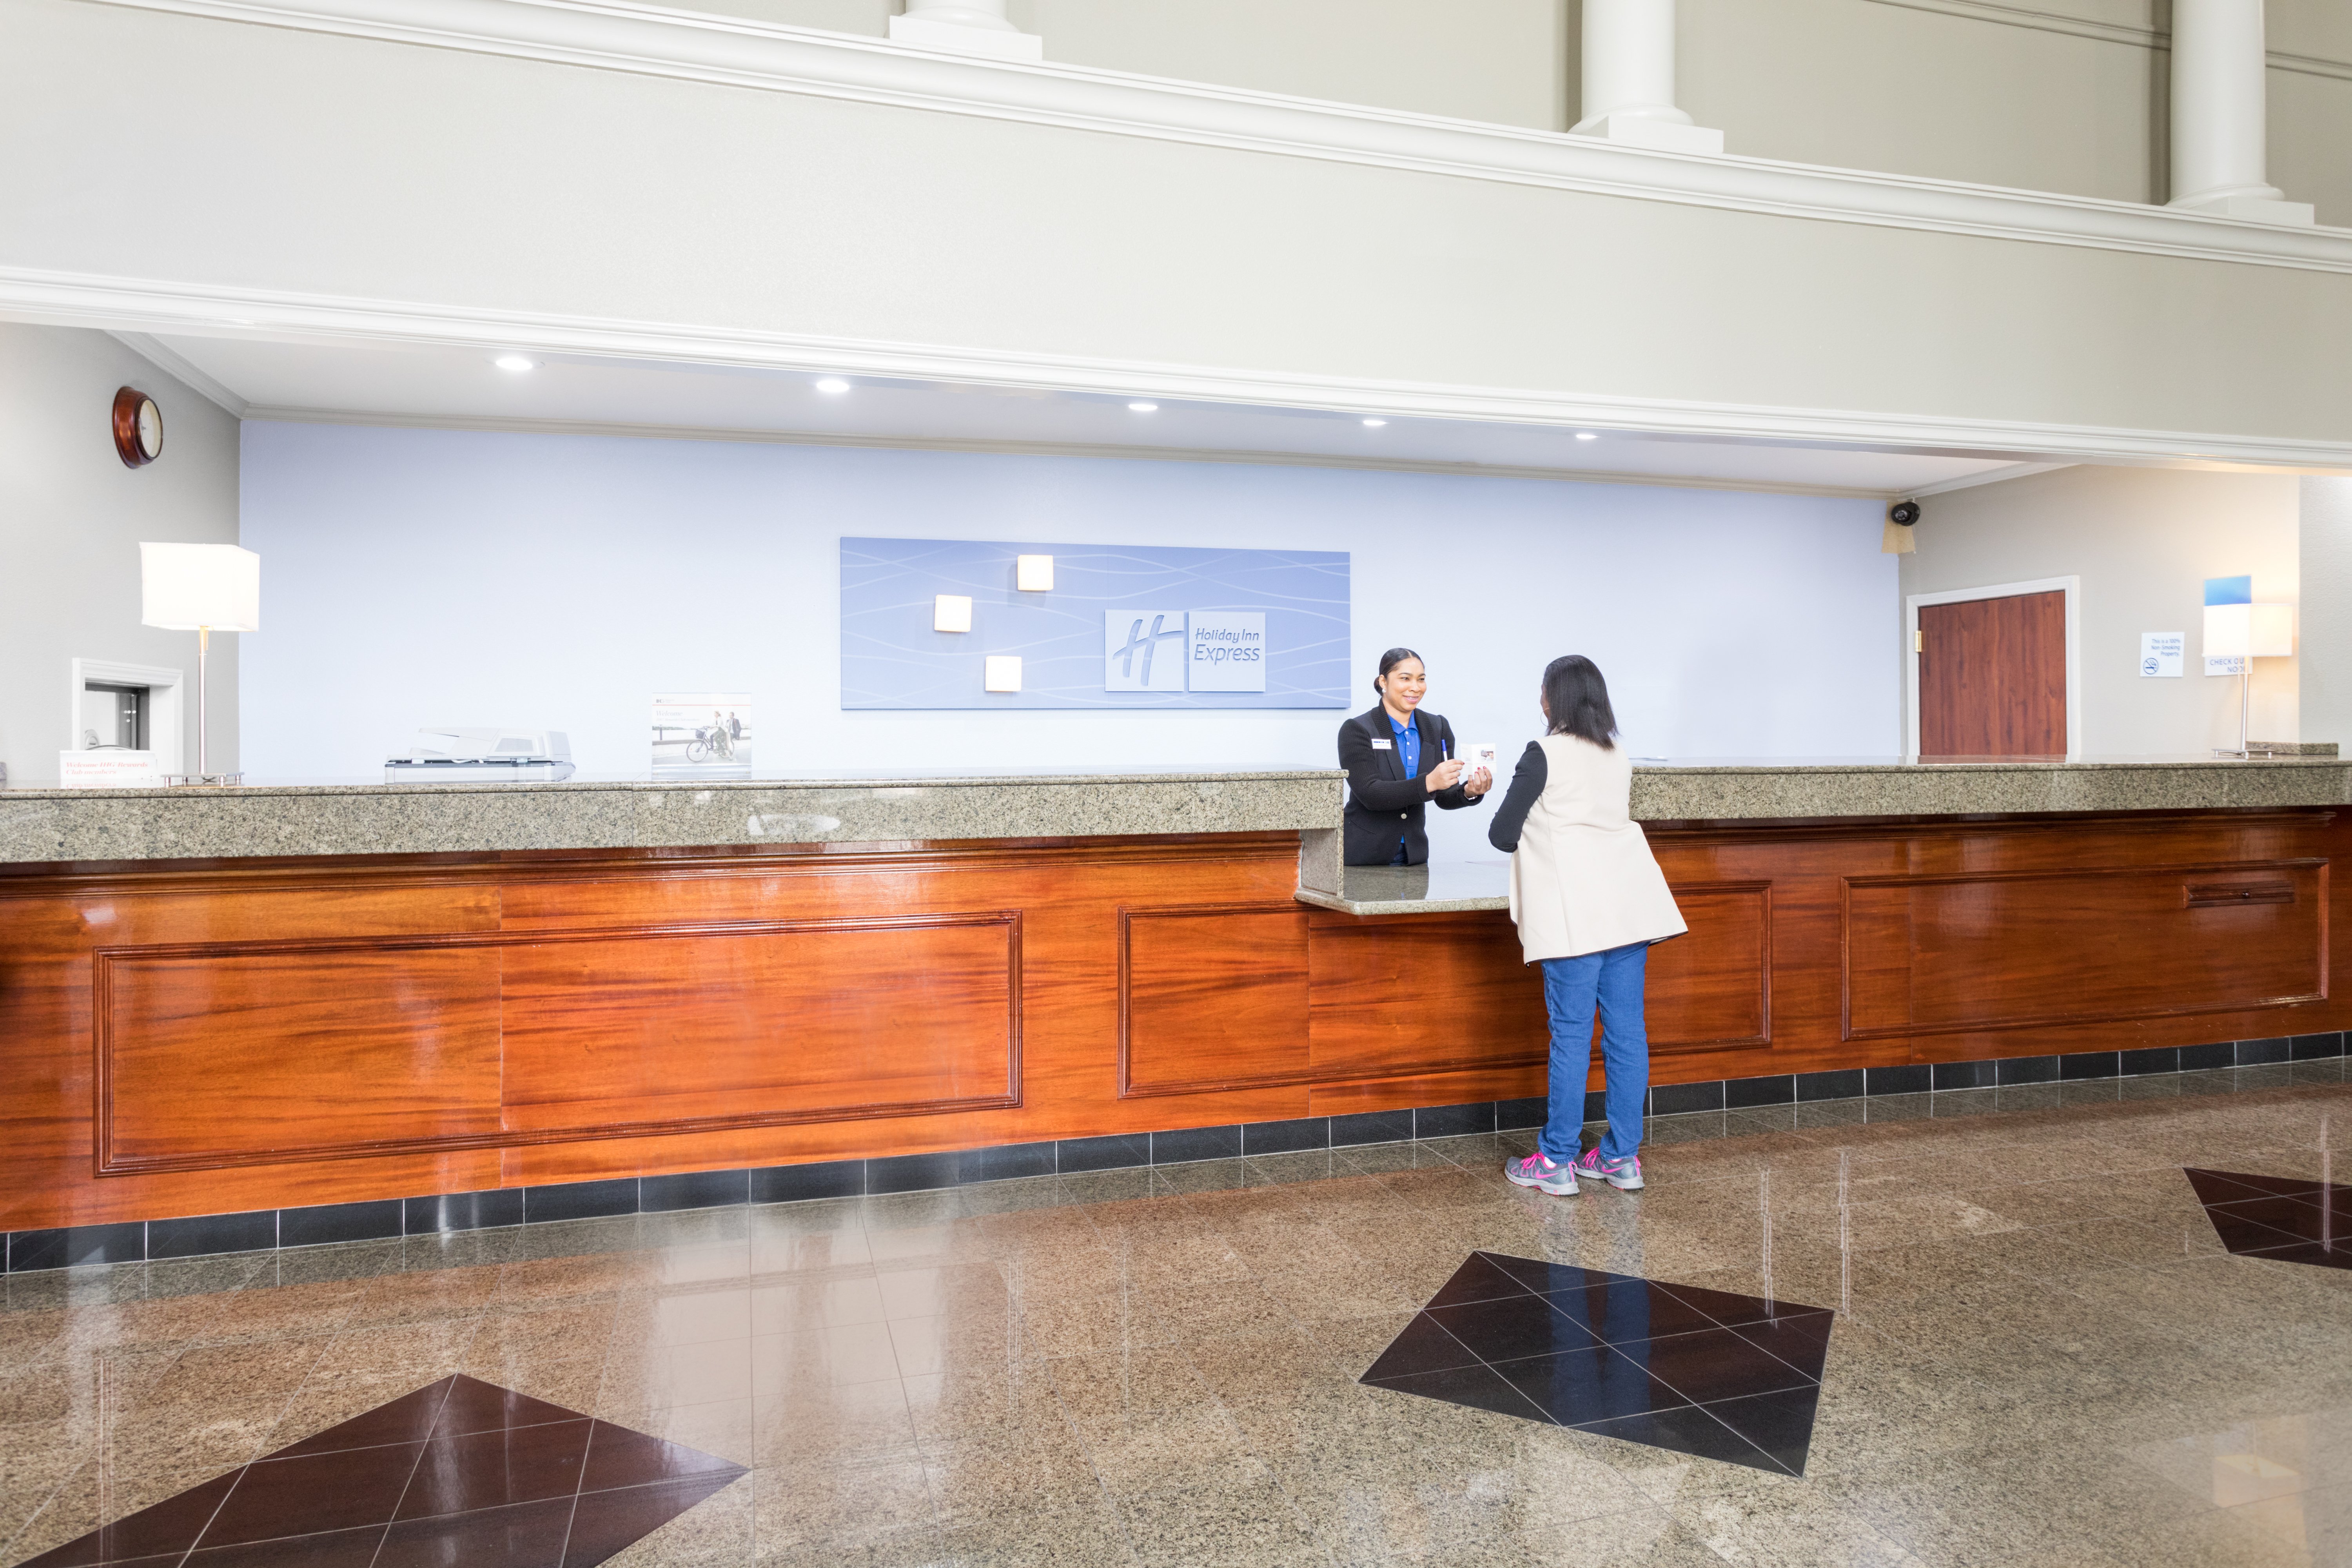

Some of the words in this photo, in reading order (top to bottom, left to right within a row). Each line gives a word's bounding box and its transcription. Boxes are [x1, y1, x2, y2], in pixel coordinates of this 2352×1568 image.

[1195, 628, 1240, 643] Holiday
[1241, 629, 1259, 641] Inn
[1194, 644, 1260, 665] Express
